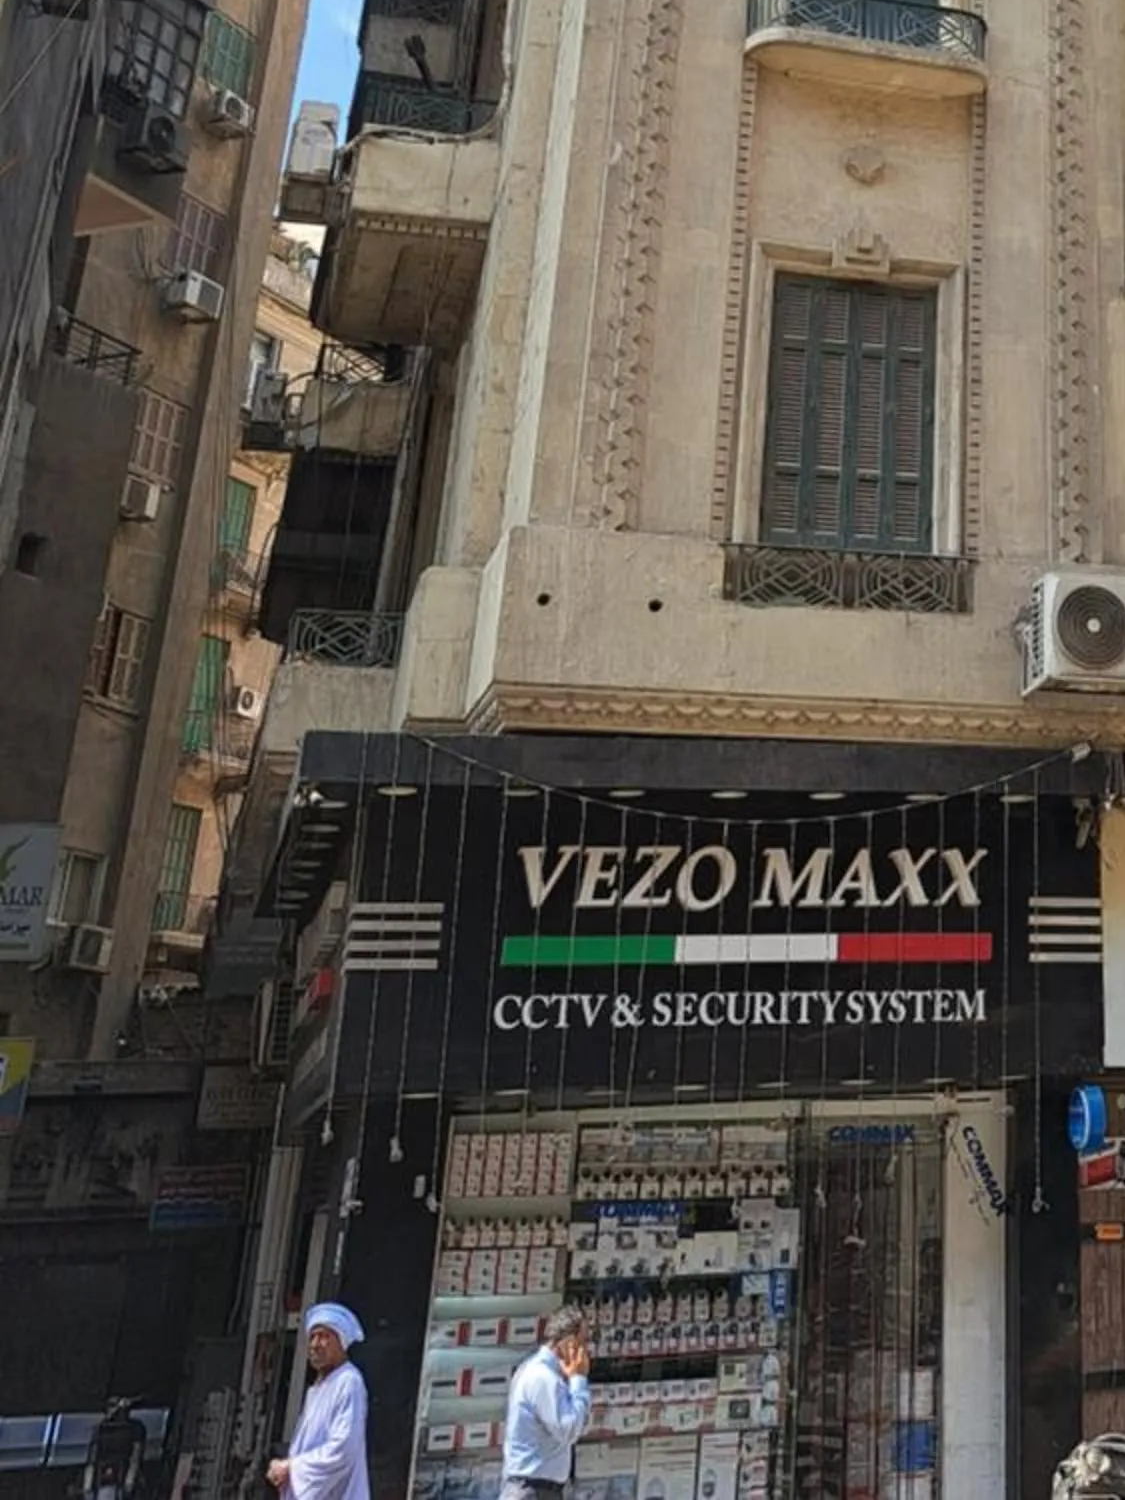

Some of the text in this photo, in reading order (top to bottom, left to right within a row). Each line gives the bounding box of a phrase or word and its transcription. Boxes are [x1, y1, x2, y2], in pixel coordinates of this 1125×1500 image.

[519, 846, 988, 911] VEZO MAXX
[493, 988, 987, 1031] CCTV & SECURITY SYSTEM
